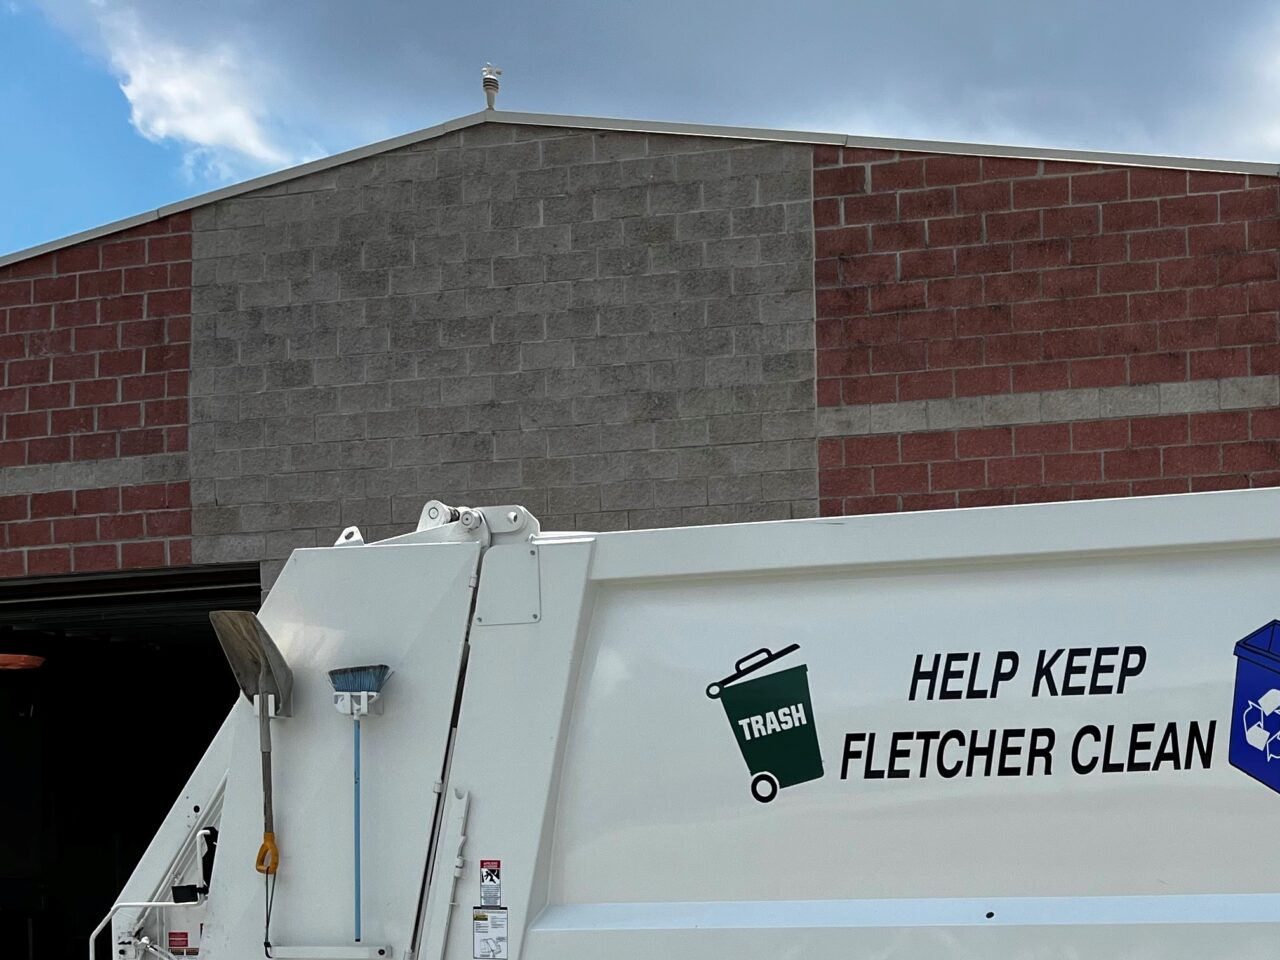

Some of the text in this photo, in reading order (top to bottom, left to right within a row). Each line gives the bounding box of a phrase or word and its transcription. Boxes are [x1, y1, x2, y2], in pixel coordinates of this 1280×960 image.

[908, 645, 1147, 701] HELP KEEP
[738, 703, 808, 741] TRASH
[840, 720, 1217, 780] FLETCHER CLEAN
